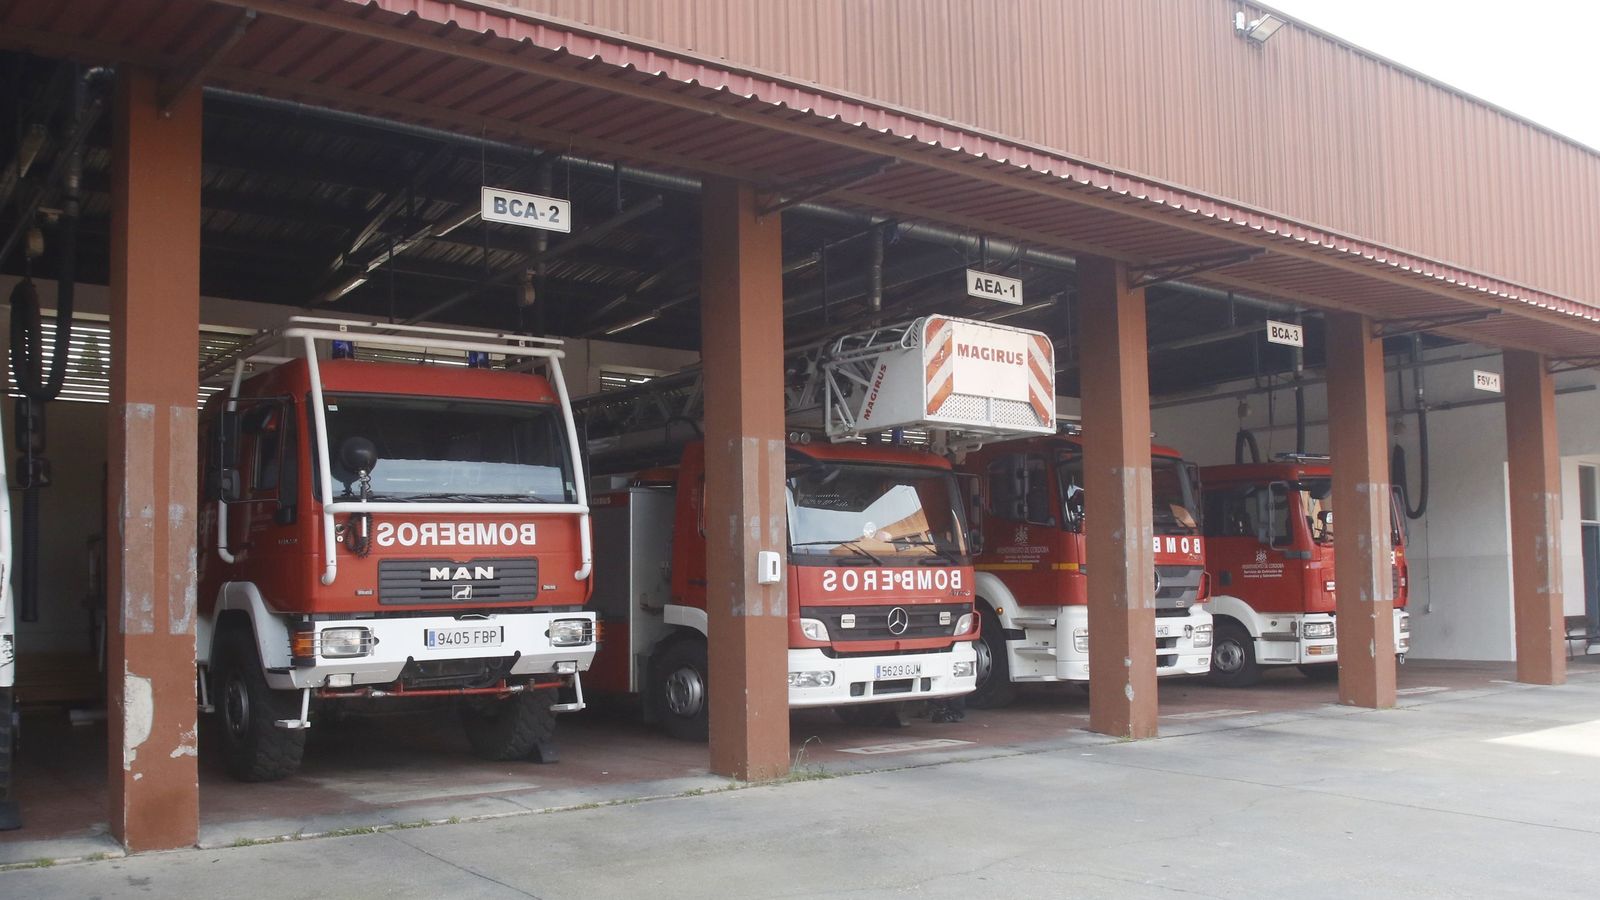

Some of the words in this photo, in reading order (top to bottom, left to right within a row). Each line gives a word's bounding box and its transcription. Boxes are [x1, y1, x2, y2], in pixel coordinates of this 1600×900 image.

[493, 196, 560, 223] BCA-2
[974, 277, 1016, 298] AEA-1
[1271, 326, 1299, 341] BCA-3
[957, 343, 1024, 366] MAGIRUS
[863, 363, 887, 421] MAGIRUS
[429, 566, 494, 581] MAN
[437, 631, 470, 645] 9405
[474, 630, 497, 644] FBP
[881, 665, 903, 677] 5629
[905, 664, 921, 675] GJM
